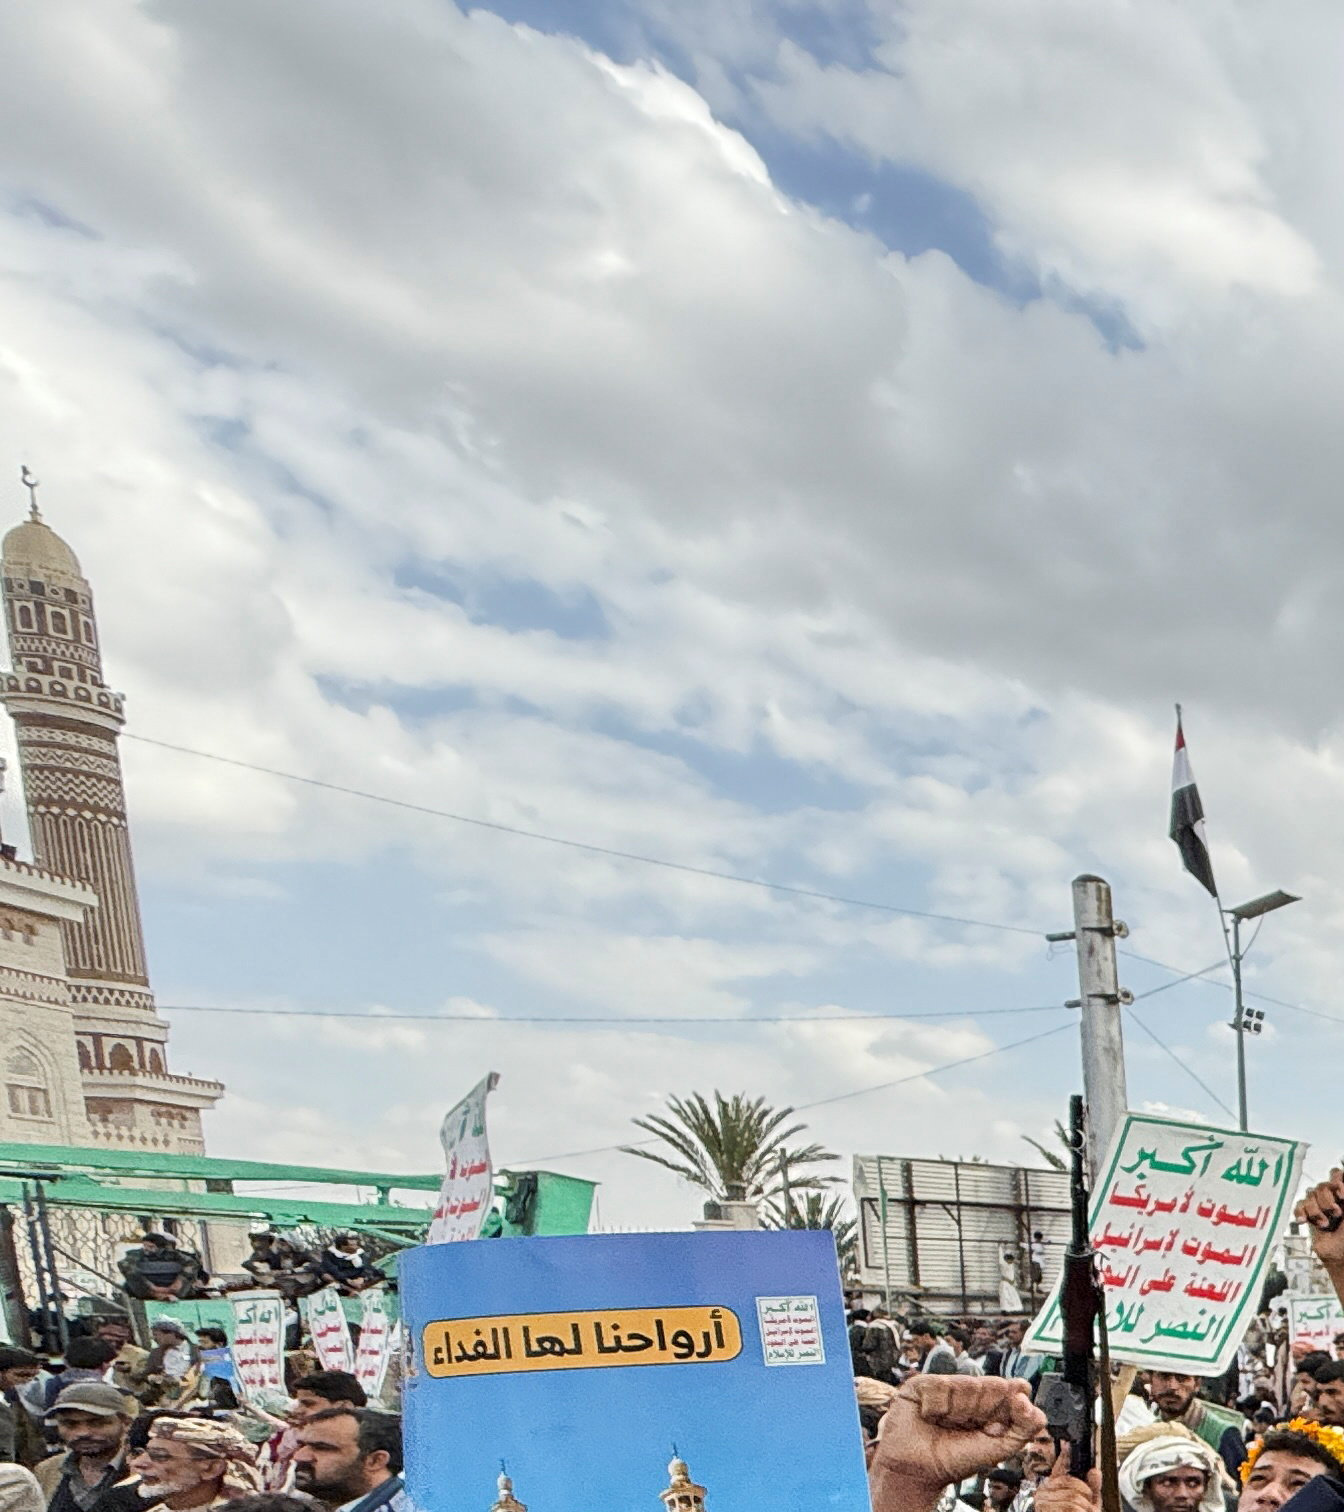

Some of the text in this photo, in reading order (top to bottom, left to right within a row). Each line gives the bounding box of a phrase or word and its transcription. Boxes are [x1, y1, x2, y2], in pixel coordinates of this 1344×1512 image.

[1120, 1134, 1284, 1188] الله أكبر
[1197, 1199, 1271, 1230] الموت
[1181, 1236, 1257, 1268] الموت
[1139, 1267, 1177, 1296] على
[1183, 1272, 1243, 1304] اللعنة
[522, 1323, 583, 1359] لها
[594, 1308, 726, 1359] أرواحنا
[1140, 1308, 1226, 1344] النصر
[432, 1326, 513, 1365] الفداء
